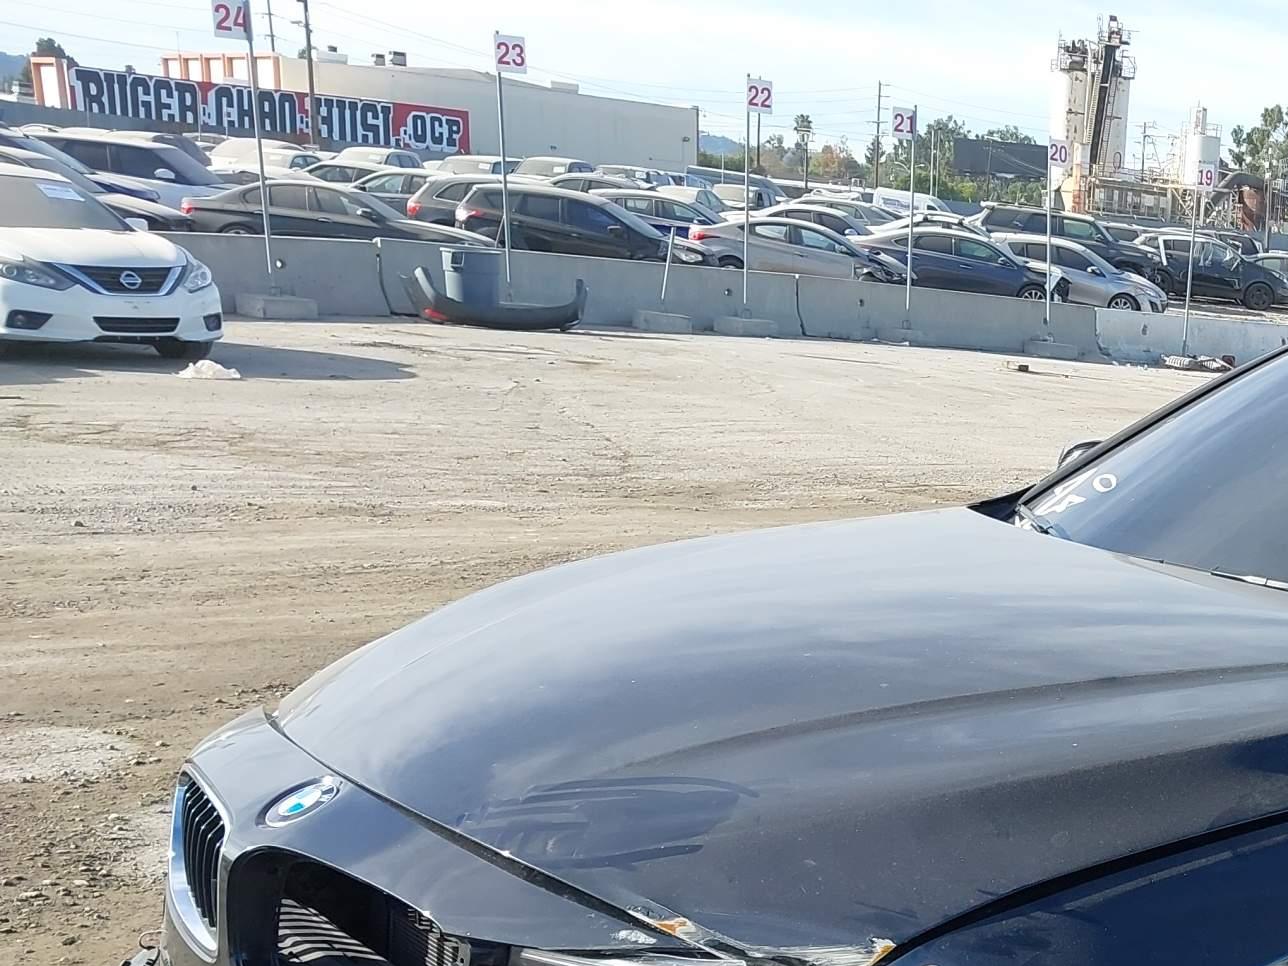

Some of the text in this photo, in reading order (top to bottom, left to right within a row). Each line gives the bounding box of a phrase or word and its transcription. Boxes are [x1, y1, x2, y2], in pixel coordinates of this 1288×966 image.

[214, 4, 247, 33] 24
[496, 42, 525, 67] 23
[748, 85, 771, 108] 22
[894, 113, 913, 133] 21
[1050, 144, 1067, 163] 20
[1198, 169, 1213, 186] 19
